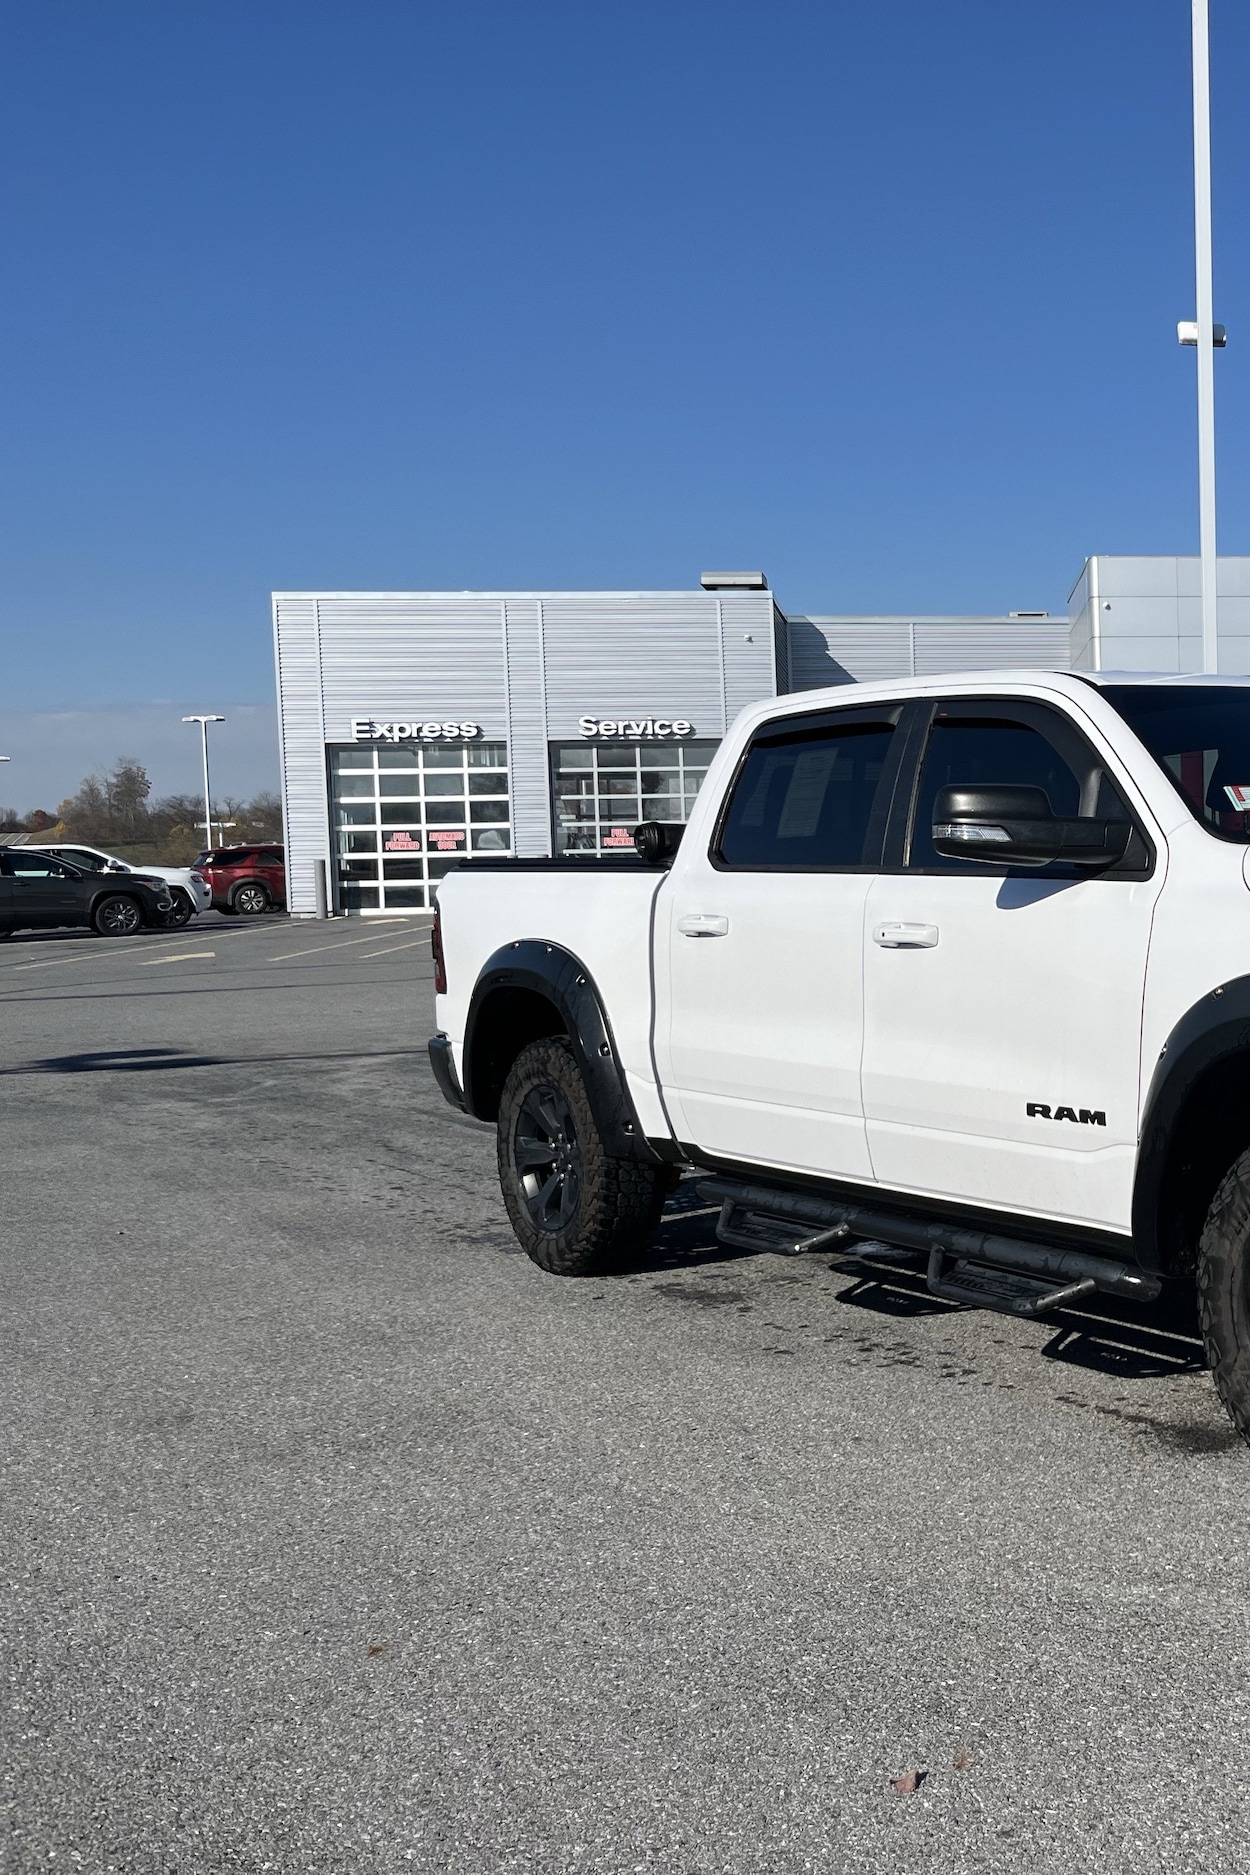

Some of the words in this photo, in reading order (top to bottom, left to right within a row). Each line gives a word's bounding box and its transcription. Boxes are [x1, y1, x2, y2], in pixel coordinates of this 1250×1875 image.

[351, 718, 479, 742] Express
[578, 715, 691, 736] Service
[385, 841, 420, 850] FORWARD
[1026, 1102, 1107, 1127] RAM
